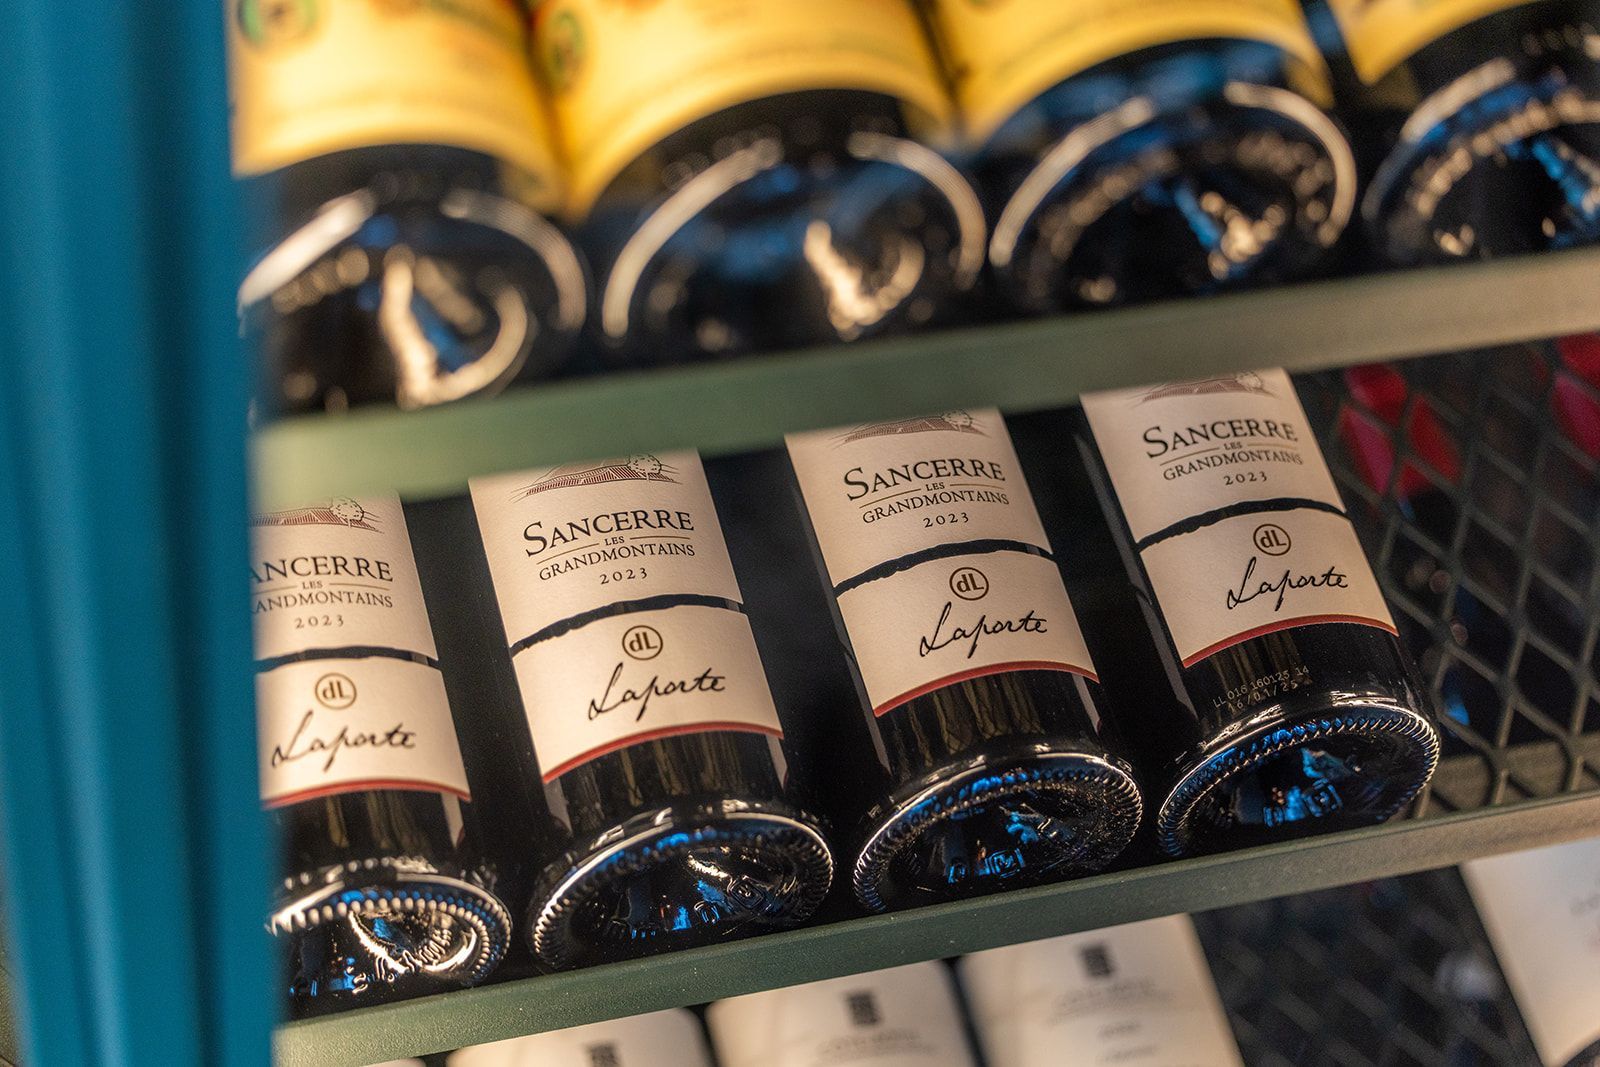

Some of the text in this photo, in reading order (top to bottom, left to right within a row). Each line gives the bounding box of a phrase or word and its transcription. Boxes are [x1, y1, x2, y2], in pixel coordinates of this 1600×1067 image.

[1223, 441, 1243, 450] LES
[1163, 451, 1304, 481] GRANDMONTAINS
[926, 482, 945, 491] LES
[1223, 471, 1268, 485] 2023
[863, 490, 1009, 524] GRANDMONTAINS
[923, 513, 969, 528] 2023
[605, 535, 625, 546] LES
[539, 543, 695, 581] GRANDMONTAINS
[600, 567, 647, 585] 2023
[1227, 556, 1348, 611] Laporte
[302, 581, 323, 590] LES
[295, 615, 344, 628] 2023
[919, 602, 1047, 658] Laporte
[588, 662, 725, 722] Laporte
[271, 710, 416, 772] Laporte
